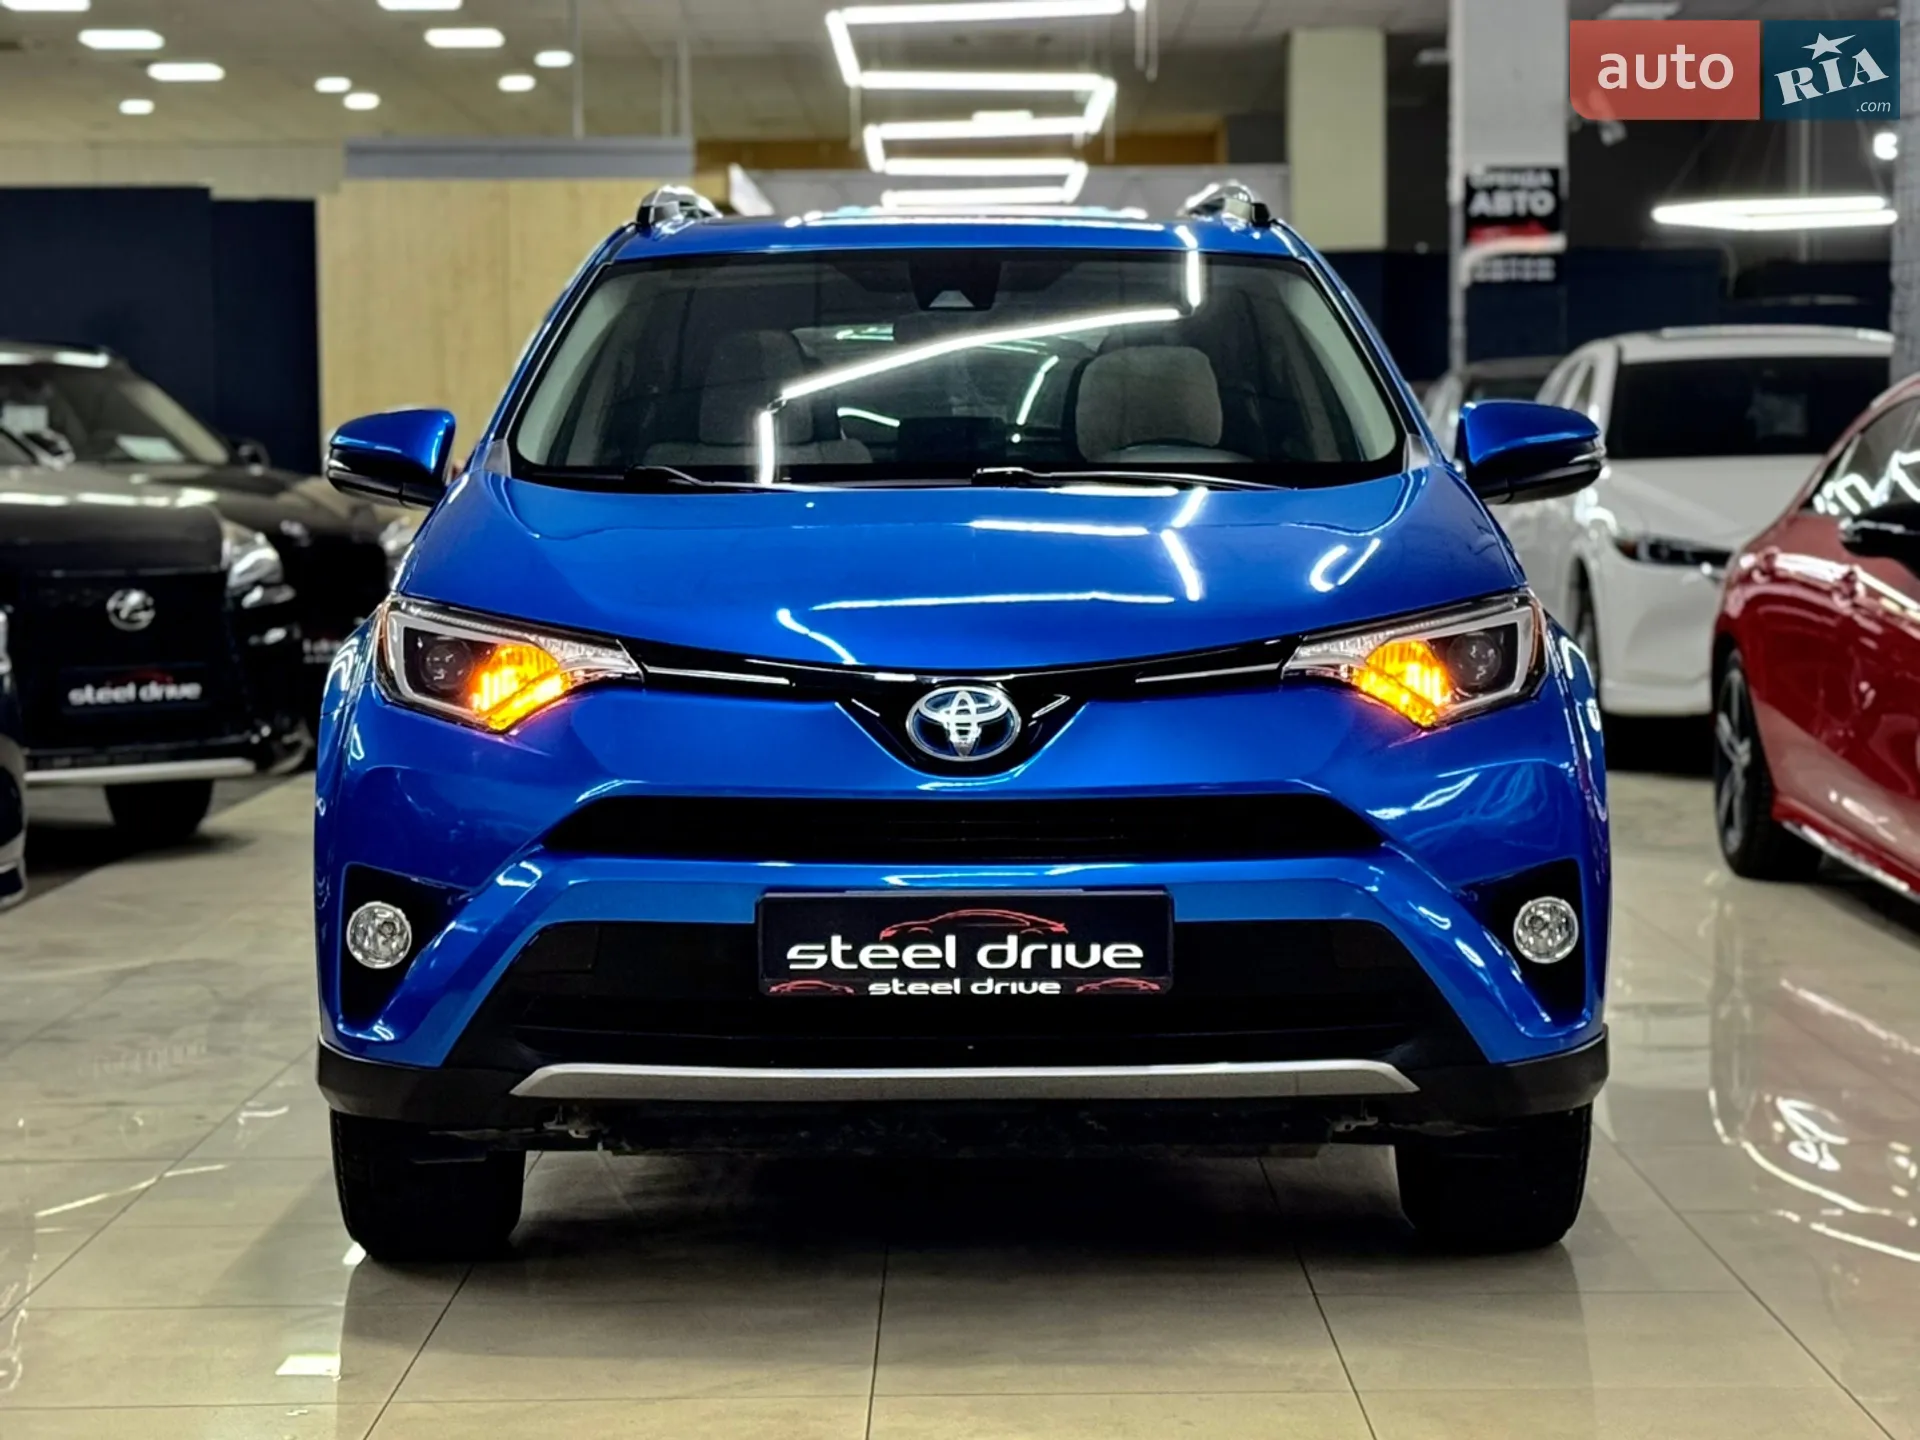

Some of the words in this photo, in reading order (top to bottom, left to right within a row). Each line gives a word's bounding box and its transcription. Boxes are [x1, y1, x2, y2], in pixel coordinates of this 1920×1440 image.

[68, 682, 137, 706] steel
[138, 681, 202, 703] drive
[786, 934, 956, 969] steel
[976, 934, 1144, 969] drive
[868, 978, 961, 996] steel
[970, 978, 1061, 996] drive
